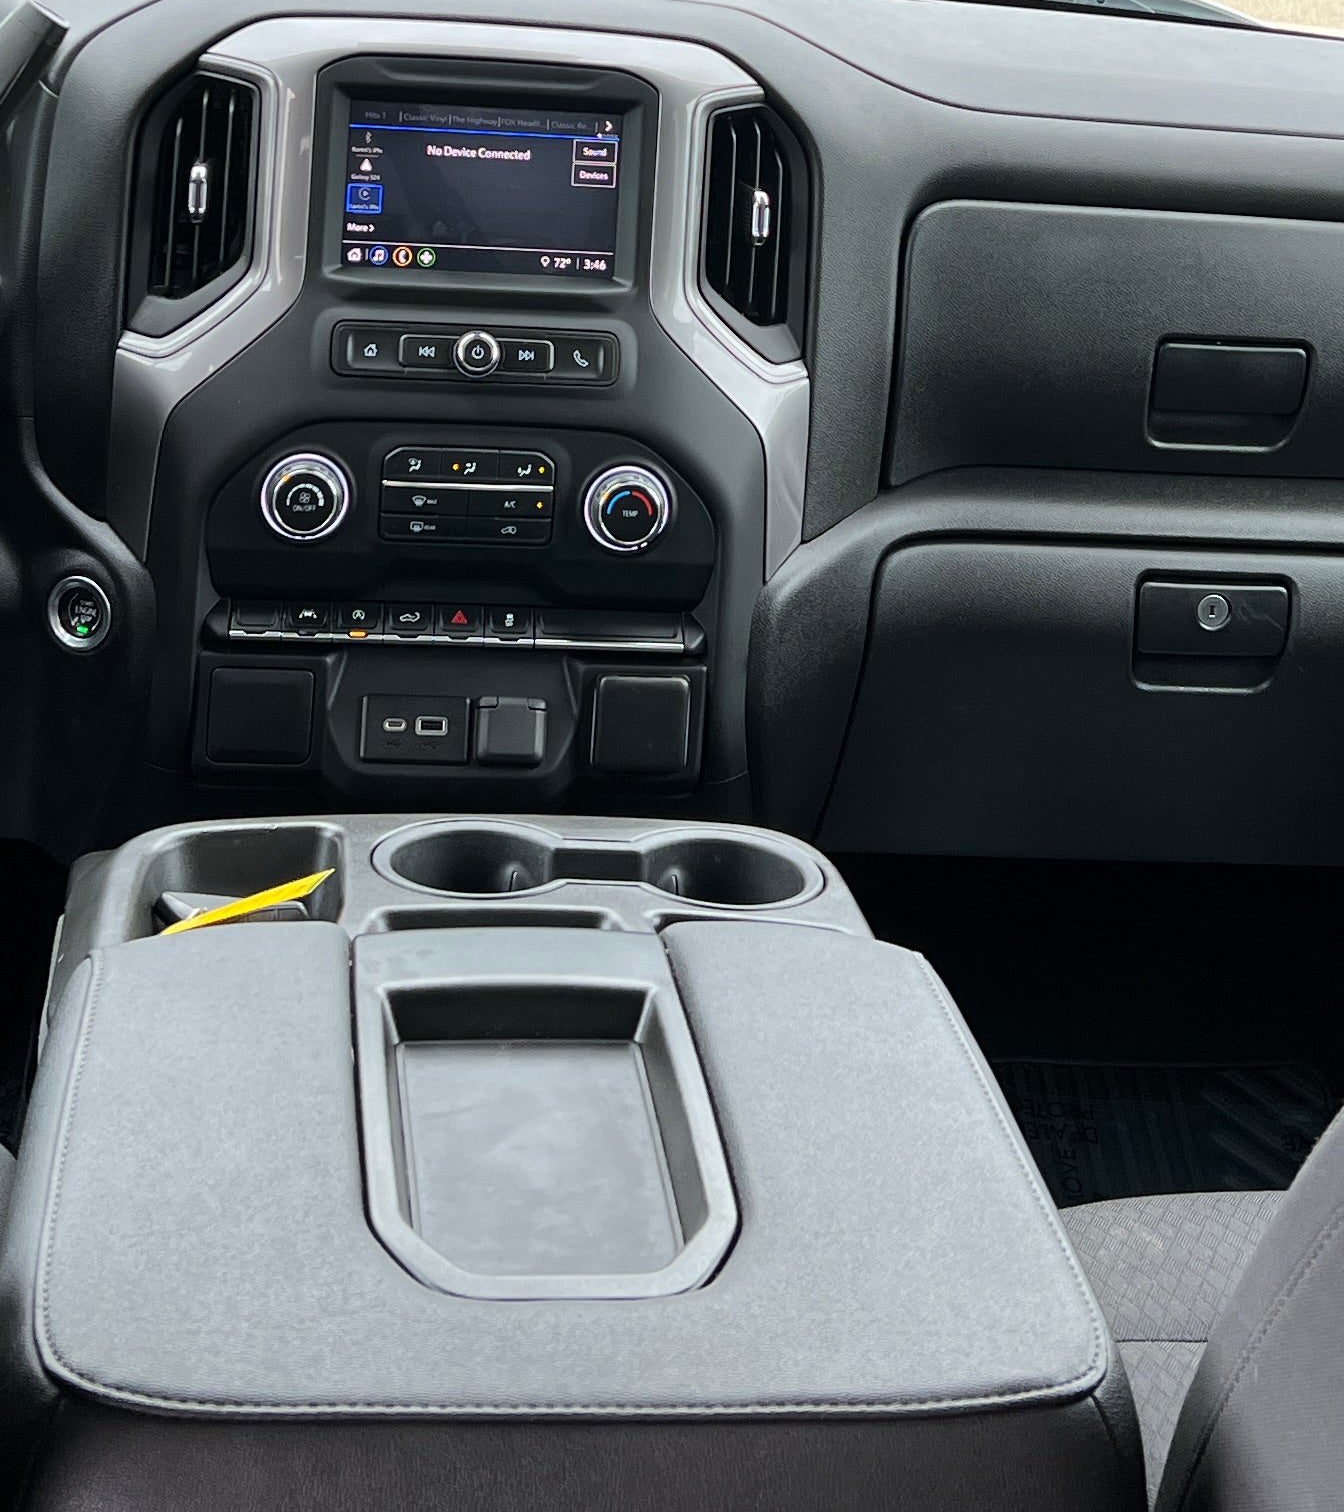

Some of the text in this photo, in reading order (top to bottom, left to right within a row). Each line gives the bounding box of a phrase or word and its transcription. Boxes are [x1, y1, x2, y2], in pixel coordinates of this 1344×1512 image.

[426, 144, 531, 161] No Device Connected
[579, 170, 609, 180] Devices
[346, 222, 369, 233] More
[583, 258, 607, 271] 3:46
[622, 509, 639, 517] TEMP
